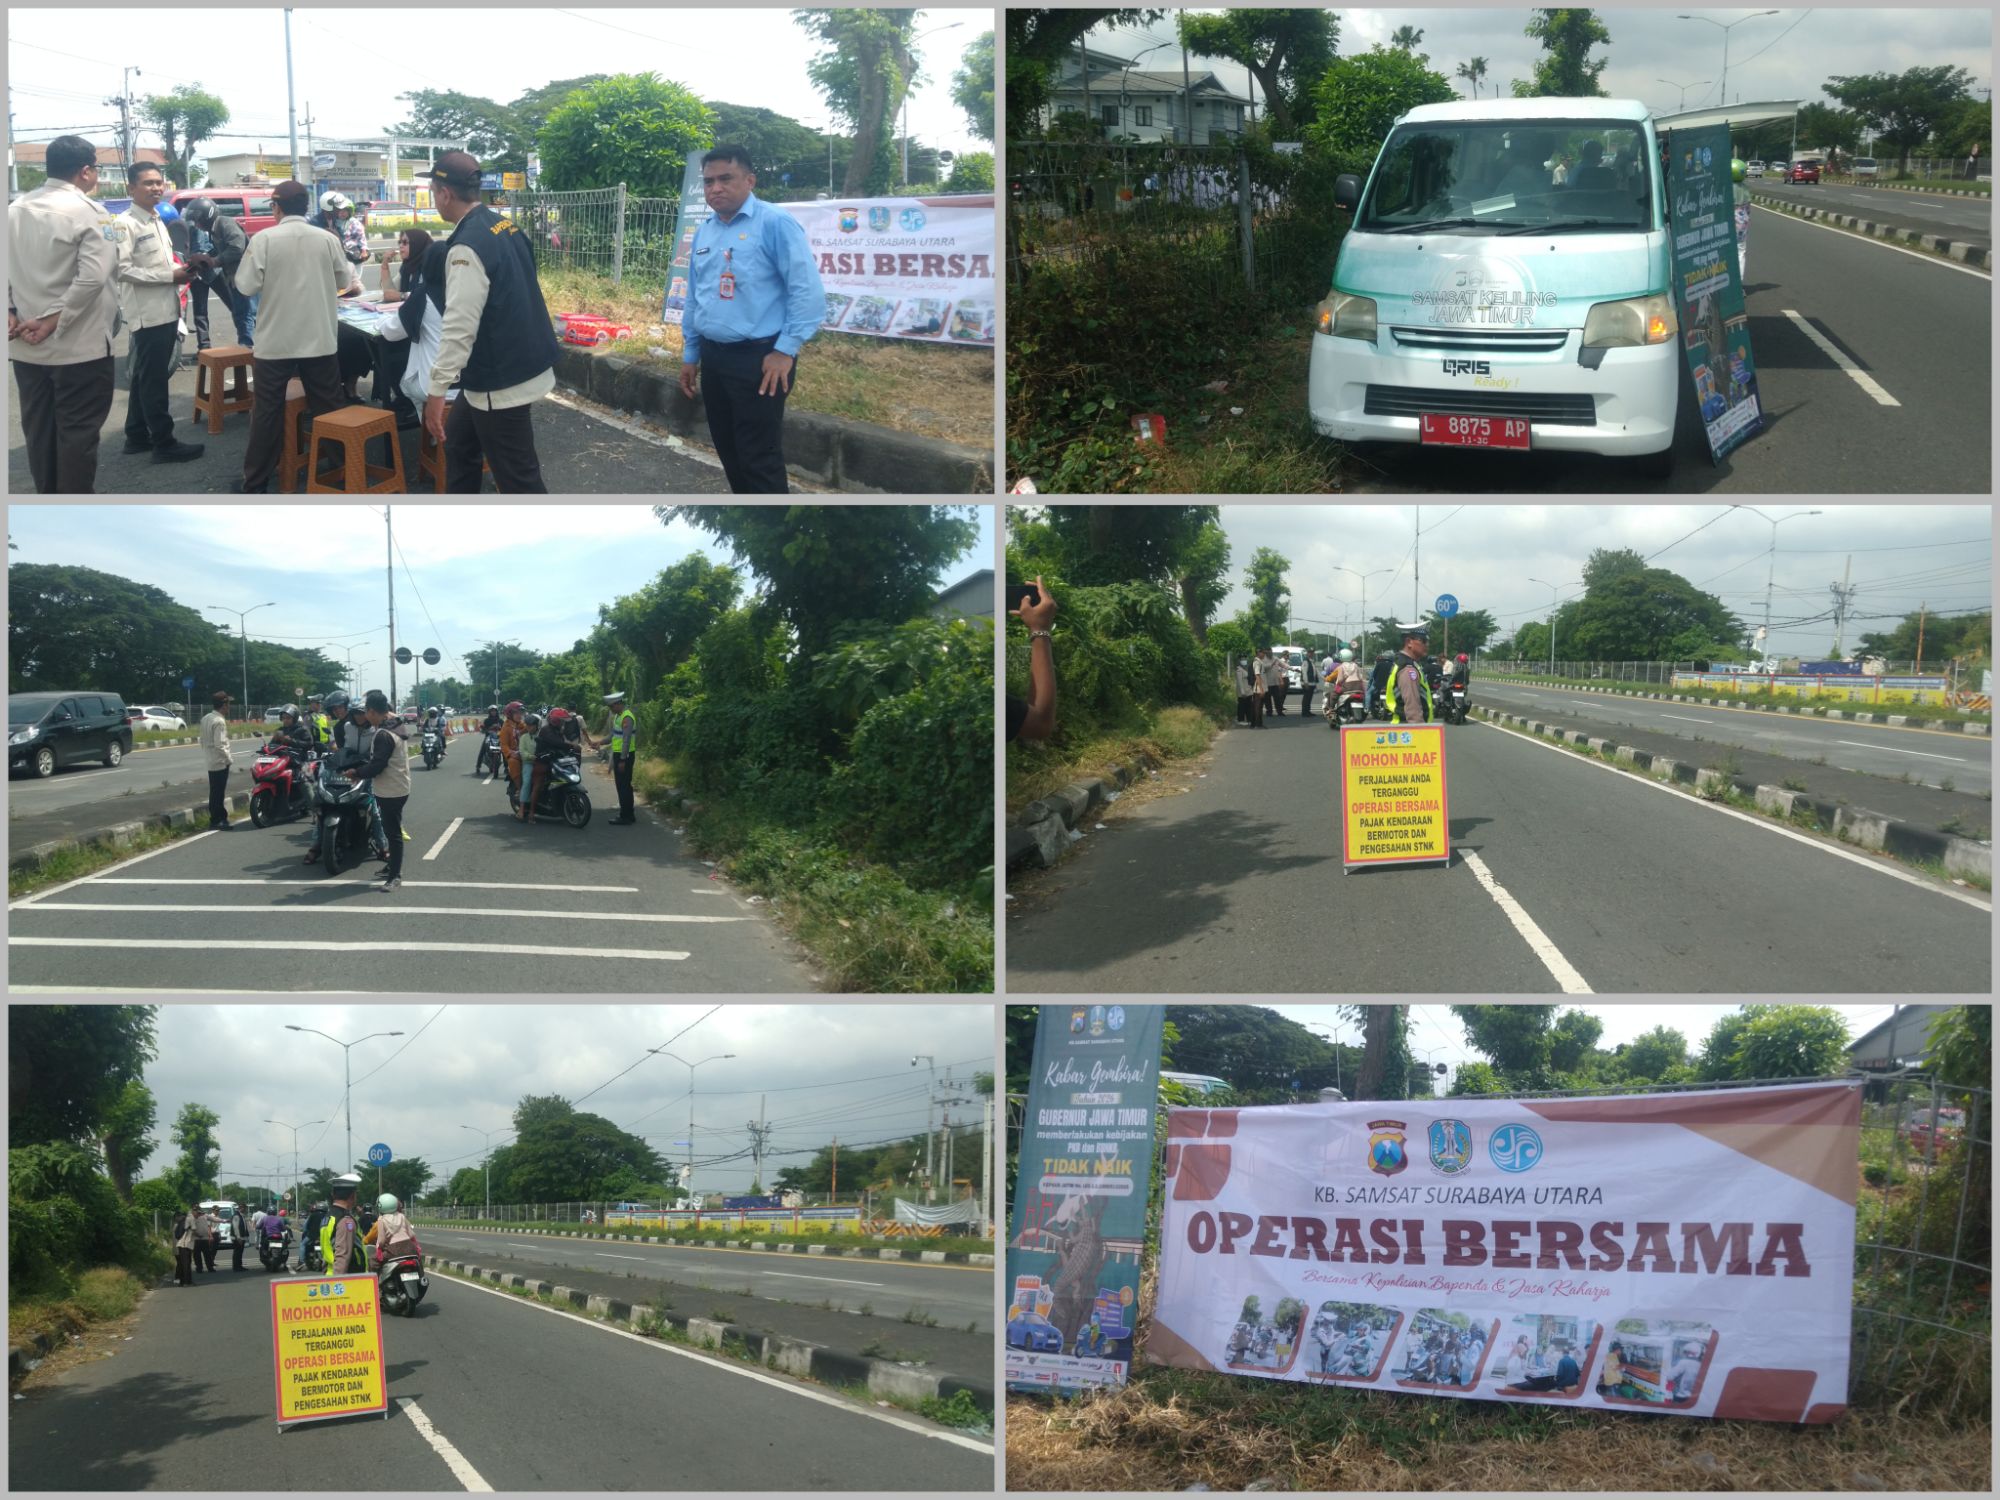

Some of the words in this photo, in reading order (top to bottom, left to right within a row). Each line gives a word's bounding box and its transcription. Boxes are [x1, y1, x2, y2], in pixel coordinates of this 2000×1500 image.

[825, 238, 864, 246] SAMSAT
[865, 238, 917, 246] SURABAYA
[919, 237, 955, 246] UTARA
[1412, 290, 1477, 306] SAMSAT
[1480, 290, 1558, 307] KELILING
[1428, 306, 1476, 323] JAWA
[1478, 307, 1534, 324] TIMUR
[1442, 358, 1491, 377] QRIS
[1474, 377, 1511, 389] Ready
[1423, 415, 1434, 433] L
[1449, 417, 1491, 435] 8875
[1505, 420, 1526, 438] AP
[1437, 600, 1450, 611] 60
[1350, 753, 1398, 766] MOHON
[1402, 752, 1437, 765] MAAF
[1359, 775, 1408, 785] PERJALANAN
[1410, 774, 1431, 783] ANDA
[1372, 787, 1419, 798] TERGANGGU
[1352, 802, 1393, 814] OPERASI
[1395, 800, 1440, 812] BERSAMA
[1360, 818, 1384, 828] PAJAK
[1387, 816, 1432, 826] KENDARAAN
[1367, 830, 1409, 841] BERMOTOR
[1411, 829, 1426, 838] DAN
[1360, 843, 1412, 854] PENGESAHAN
[1414, 841, 1434, 851] STNK
[1044, 1057, 1087, 1087] Kabar
[1089, 1055, 1149, 1093] Gembira!
[1039, 1109, 1087, 1126] GUBERNUR
[1089, 1109, 1115, 1126] JAWA
[1118, 1108, 1148, 1126] TIMUR
[1037, 1130, 1104, 1139] memberlakukan
[1106, 1130, 1148, 1141] kebijakan
[370, 1149, 383, 1161] 60
[1043, 1158, 1089, 1174] TIDAK
[1094, 1160, 1133, 1175] NAIK
[1314, 1186, 1339, 1203] KB.
[1345, 1186, 1422, 1204] SAMSAT
[1424, 1187, 1531, 1204] SURABAYA
[1534, 1187, 1603, 1204] UTARA
[1187, 1210, 1426, 1265] OPERASI
[1442, 1219, 1811, 1277] BERSAMA
[1302, 1269, 1358, 1286] Bersama
[1360, 1271, 1428, 1291] Kepolisian
[1429, 1275, 1488, 1295] Bapenda
[1491, 1277, 1505, 1293] &
[1508, 1279, 1545, 1299] Jasa
[1548, 1279, 1611, 1301] Raharja
[281, 1305, 332, 1321] MOHON
[336, 1302, 371, 1317] MAAF
[291, 1327, 343, 1339] PERJALANAN
[345, 1324, 366, 1334] ANDA
[305, 1339, 354, 1352] TERGANGGU
[284, 1355, 327, 1370] OPERASI
[330, 1350, 376, 1365] BERSAMA
[293, 1372, 319, 1383] PAJAK
[321, 1367, 369, 1380] KENDARAAN
[301, 1383, 345, 1397] BERMOTOR
[347, 1381, 363, 1391] DAN
[294, 1396, 348, 1411] PENGESAHAN
[350, 1393, 371, 1404] STNK
